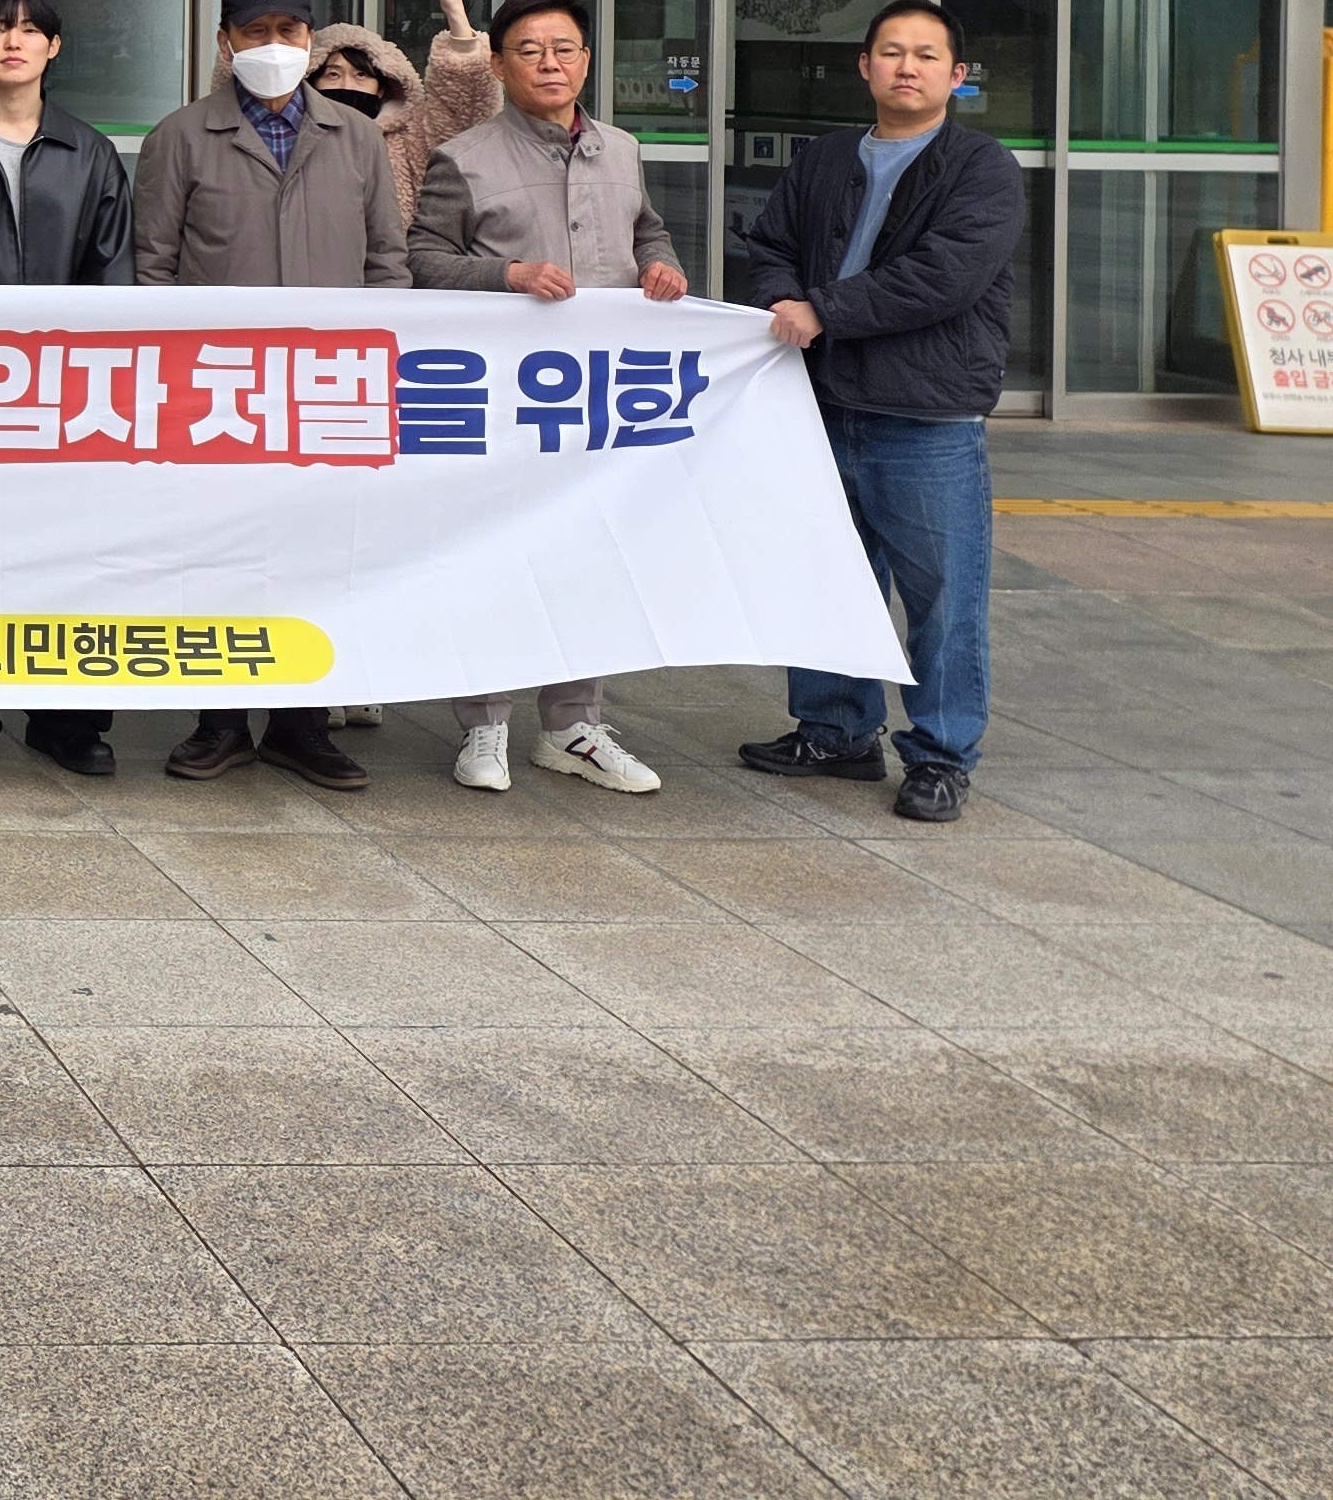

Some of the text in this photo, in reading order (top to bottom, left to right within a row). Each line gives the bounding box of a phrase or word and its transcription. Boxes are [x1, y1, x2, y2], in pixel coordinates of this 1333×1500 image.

[666, 56, 701, 69] 자동문
[1269, 347, 1304, 367] 청사
[1273, 368, 1308, 389] 출입
[188, 343, 489, 456] 처벌을
[516, 348, 710, 453] 위한
